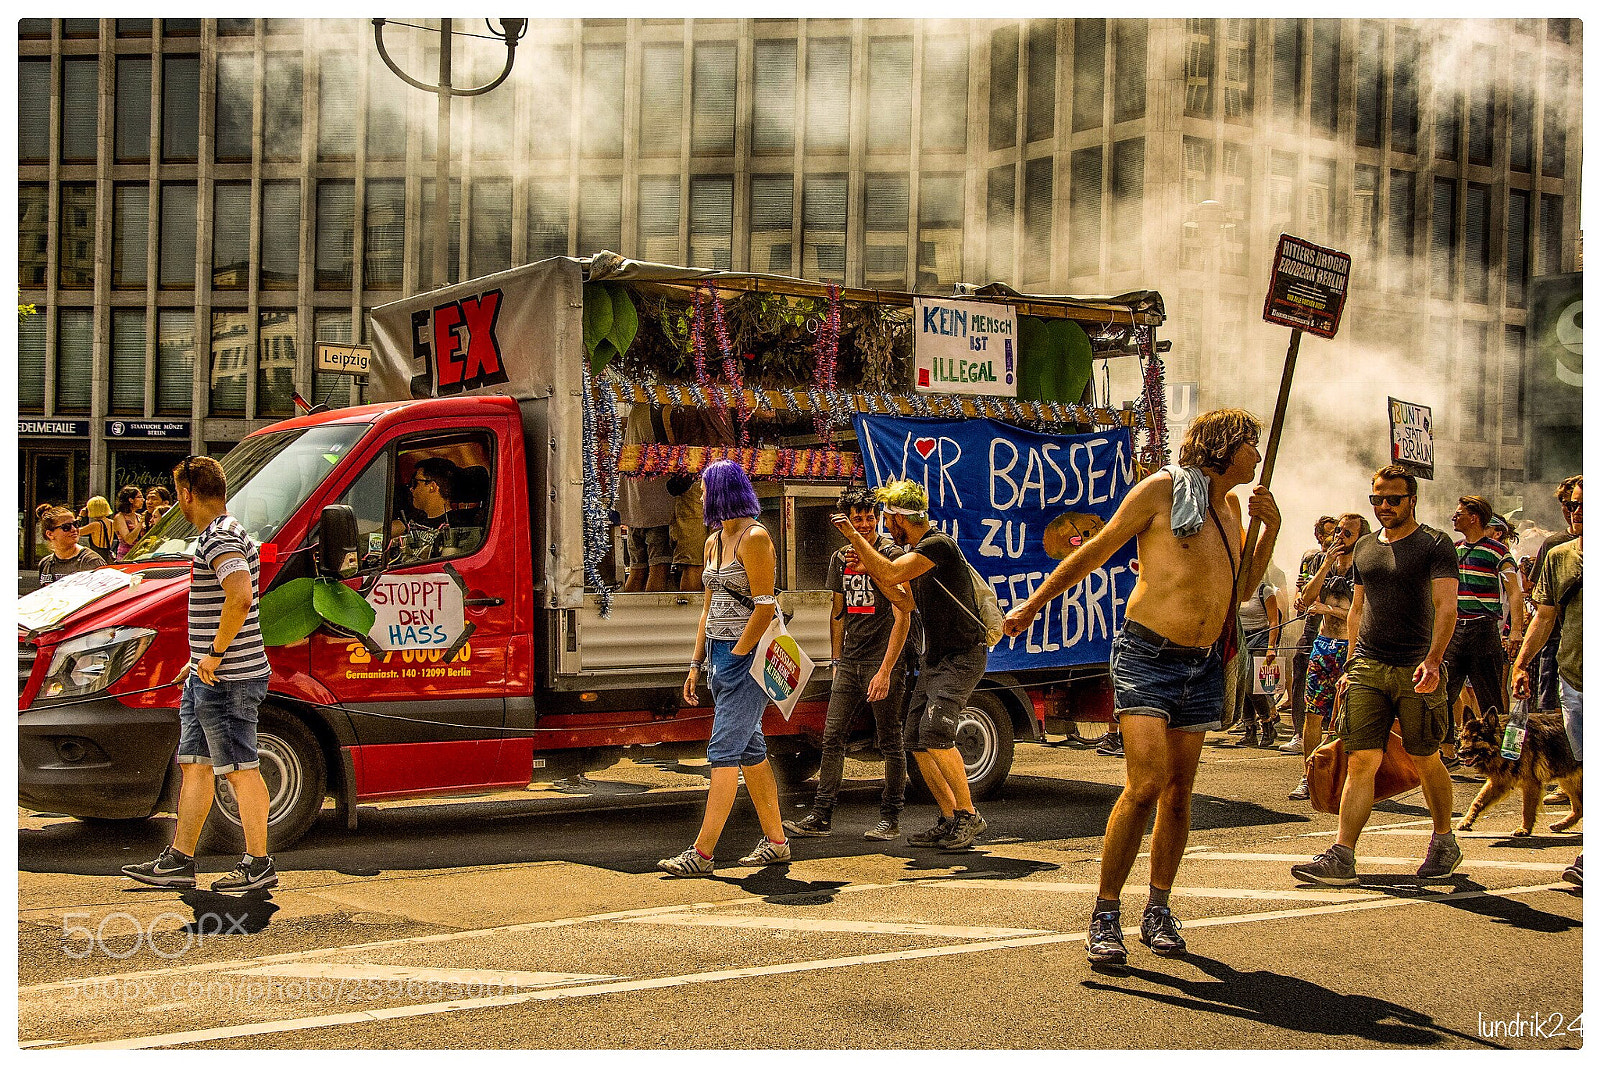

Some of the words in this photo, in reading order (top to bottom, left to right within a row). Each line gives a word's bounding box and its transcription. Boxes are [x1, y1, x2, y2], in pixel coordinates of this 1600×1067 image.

[1282, 240, 1315, 265] HITLERS
[1315, 251, 1349, 275] DROGEN
[1278, 256, 1316, 282] EROBERN
[1316, 268, 1346, 291] BERLIN
[923, 306, 967, 338] KEIN
[971, 314, 1012, 335] MENSCH
[970, 335, 989, 351] IST
[932, 356, 997, 383] ILLEGAL
[163, 422, 184, 430] MÜNZE
[1393, 402, 1421, 426] BUNT
[1402, 437, 1432, 463] BRAUN
[989, 438, 1133, 511] BASSEN
[978, 518, 1027, 559] ZU
[842, 574, 875, 591] FCK
[373, 581, 449, 611] STOPPT
[398, 609, 434, 626] DEN
[388, 624, 448, 646] HASS
[345, 669, 399, 680] Germaniastr.
[402, 668, 416, 678] 140
[422, 668, 445, 678] 12099
[447, 667, 471, 677] Berlin
